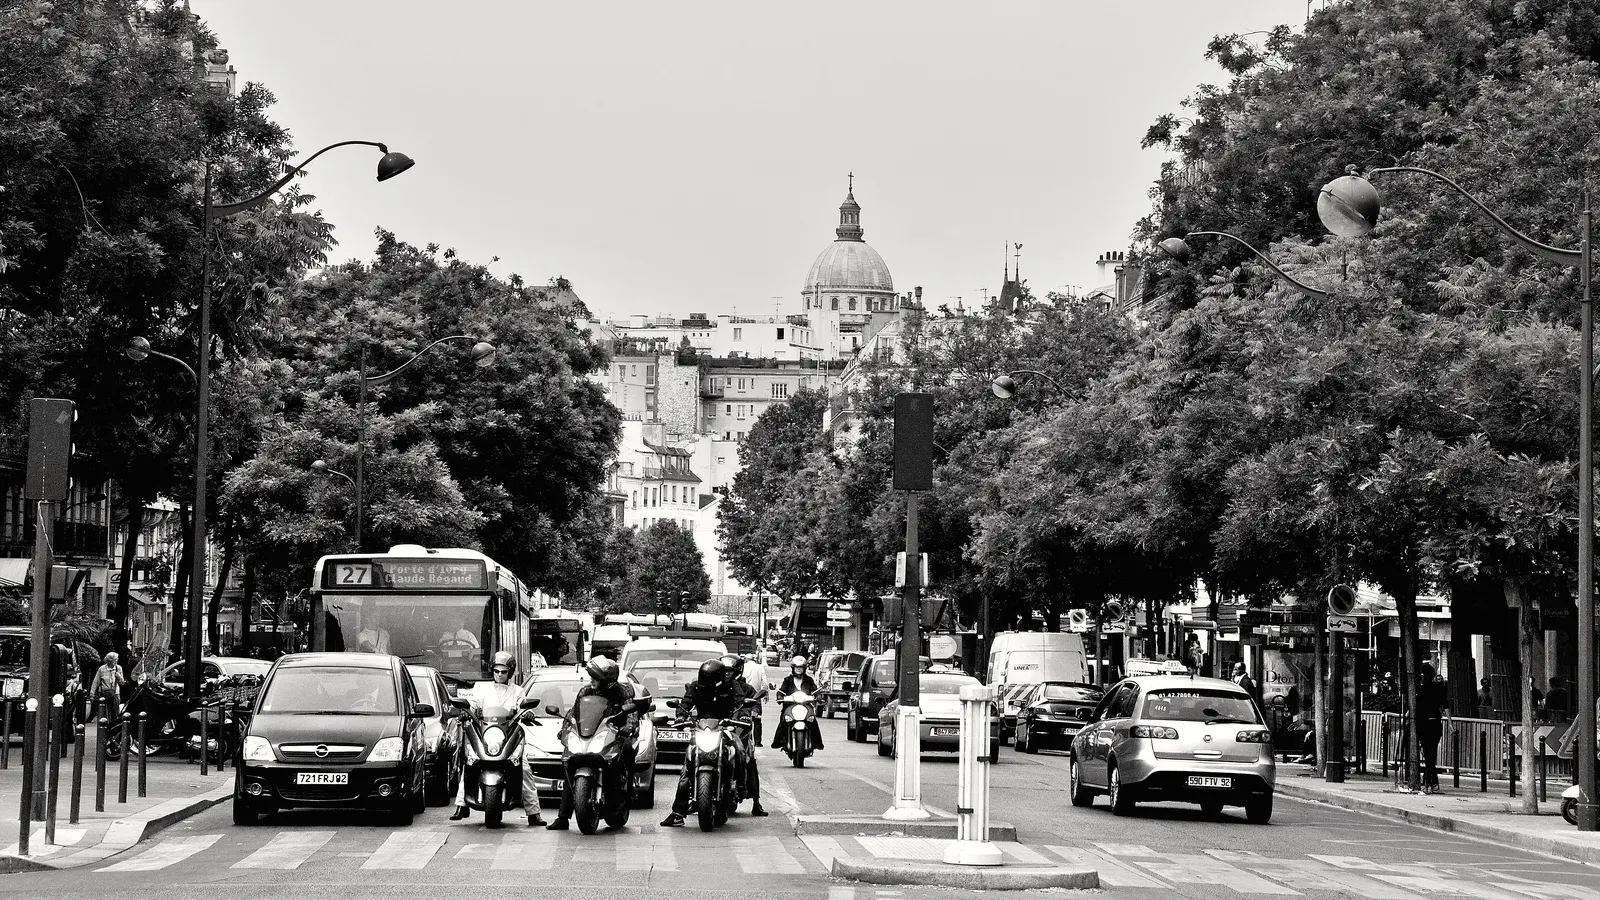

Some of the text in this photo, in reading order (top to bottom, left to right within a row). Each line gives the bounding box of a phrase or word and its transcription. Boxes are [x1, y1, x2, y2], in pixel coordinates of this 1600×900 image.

[343, 566, 367, 583] 27
[391, 564, 424, 574] Porte
[385, 572, 472, 585] Claude Régaud
[1265, 670, 1294, 684] Dior
[1205, 777, 1218, 786] FTV
[1220, 778, 1230, 787] 92
